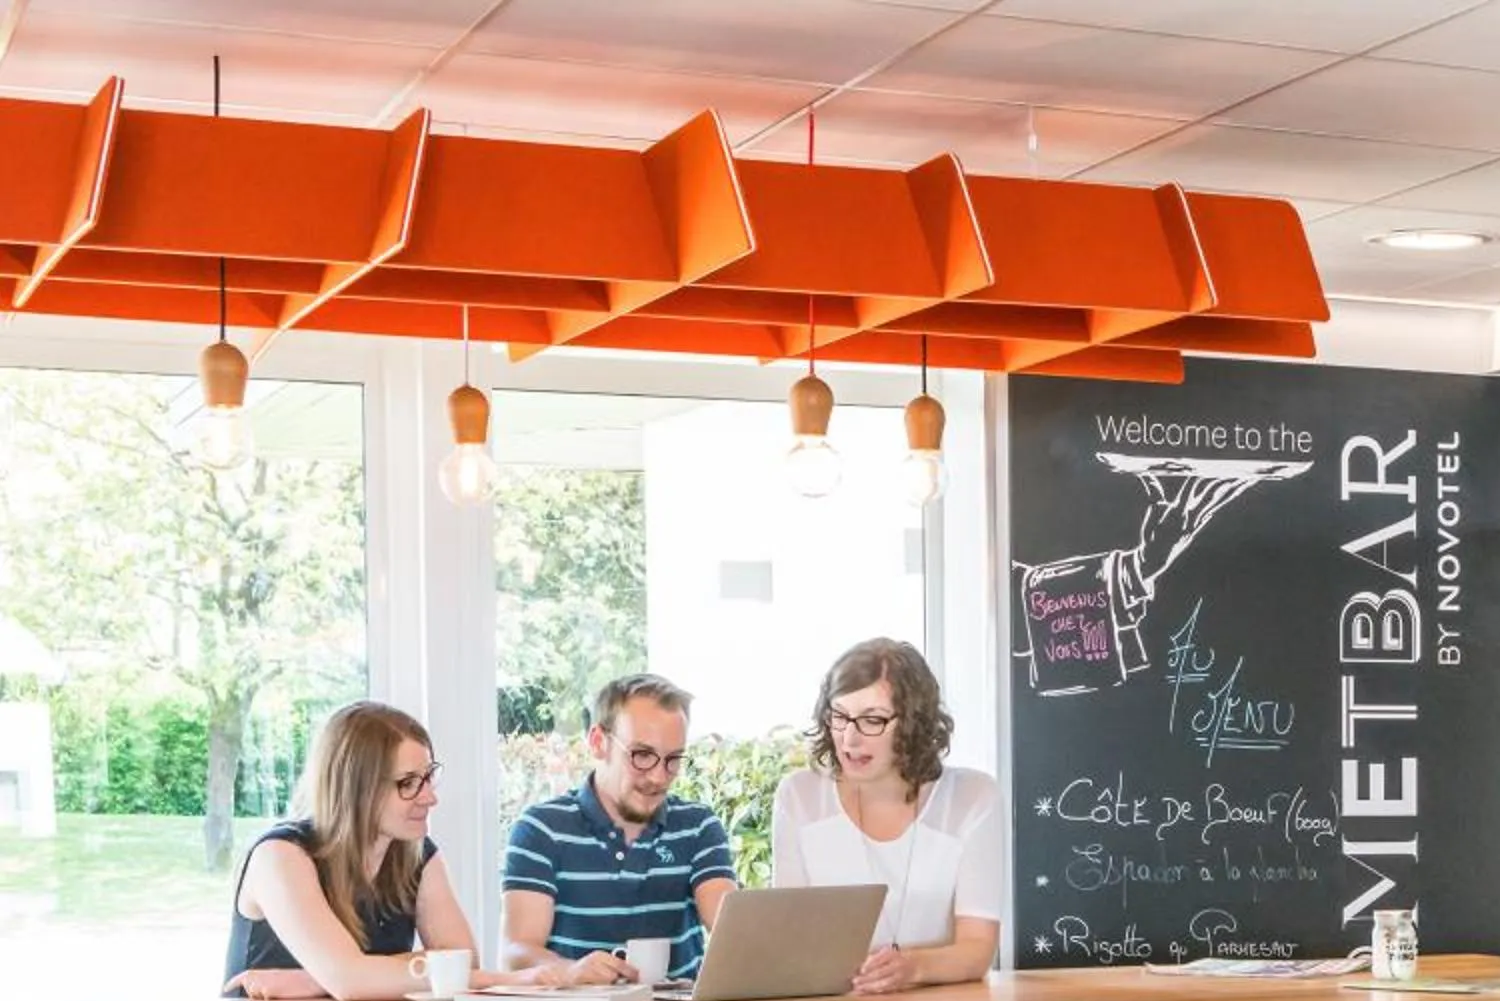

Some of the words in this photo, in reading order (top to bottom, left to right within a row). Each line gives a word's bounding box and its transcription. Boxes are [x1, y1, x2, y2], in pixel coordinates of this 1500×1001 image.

[1096, 414, 1227, 449] Welcome
[1234, 423, 1261, 450] to
[1268, 422, 1313, 453] the
[1437, 431, 1460, 611] NOVOTEL
[1437, 624, 1460, 665] BY
